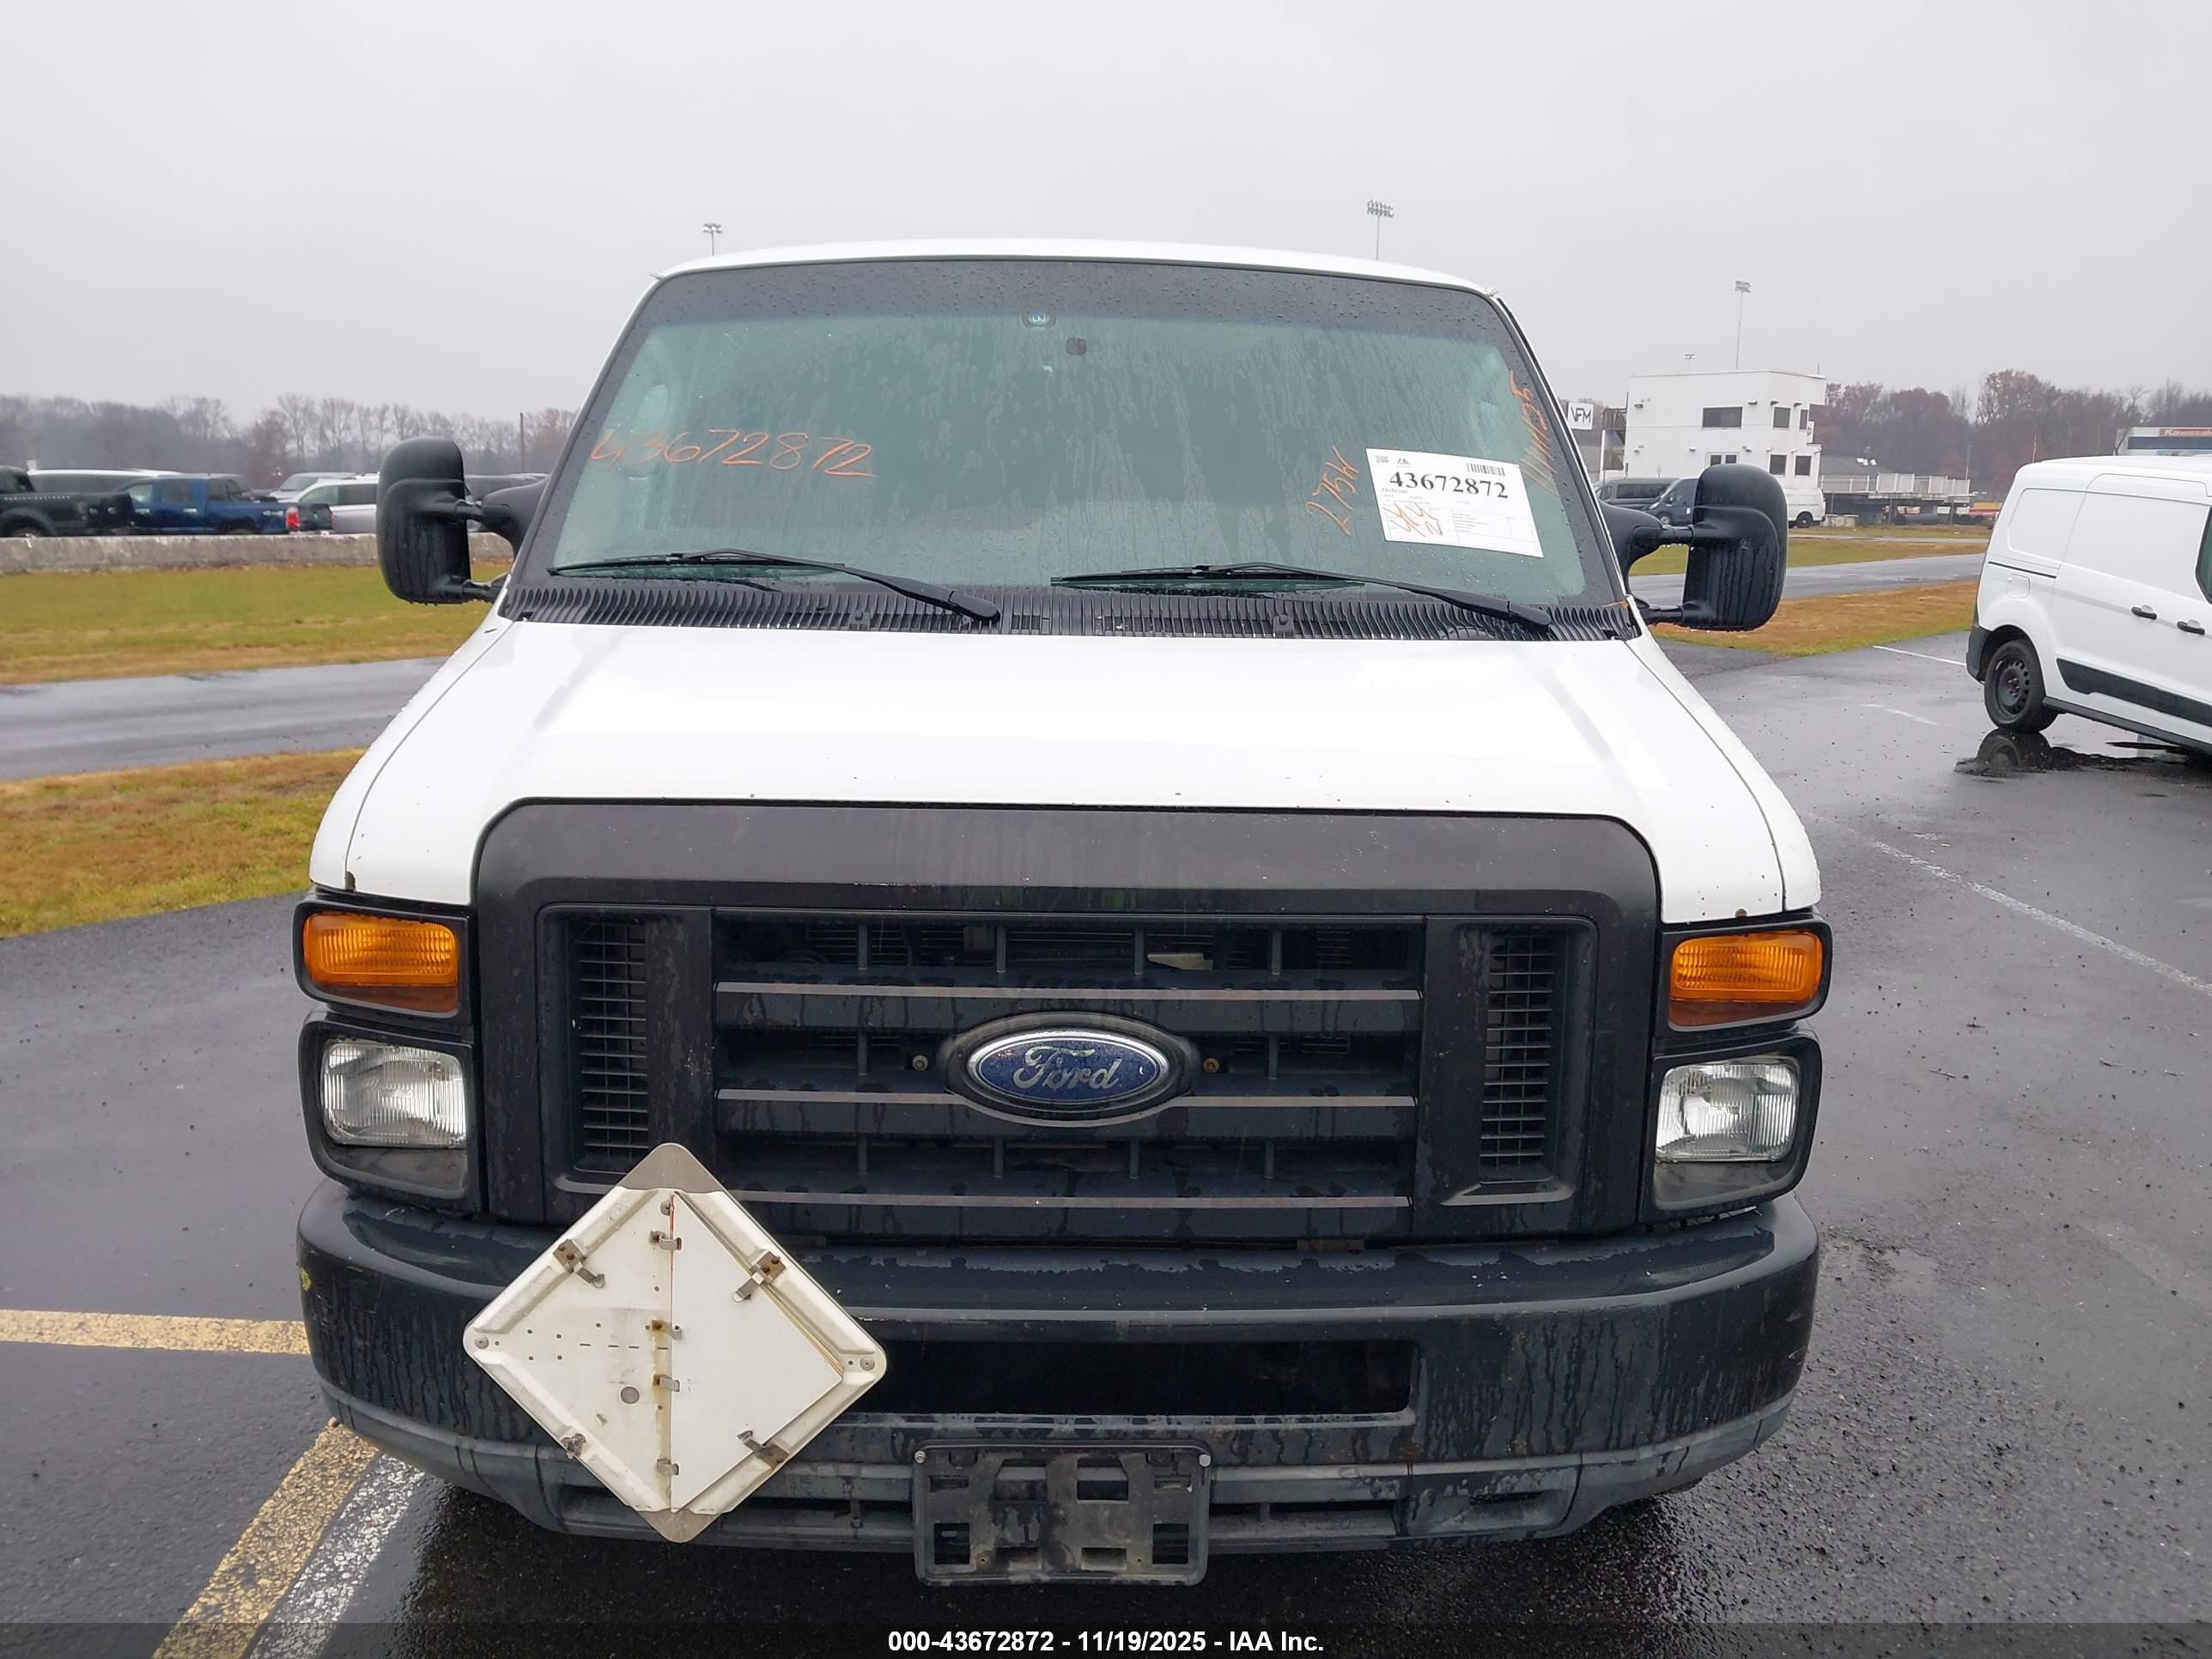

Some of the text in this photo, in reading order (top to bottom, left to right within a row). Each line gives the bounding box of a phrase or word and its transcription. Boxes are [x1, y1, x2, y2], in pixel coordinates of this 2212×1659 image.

[1571, 406, 1592, 423] VFM
[591, 428, 878, 479] 43672872
[1389, 471, 1509, 499] 43672872
[1013, 1045, 1123, 1090] Ford
